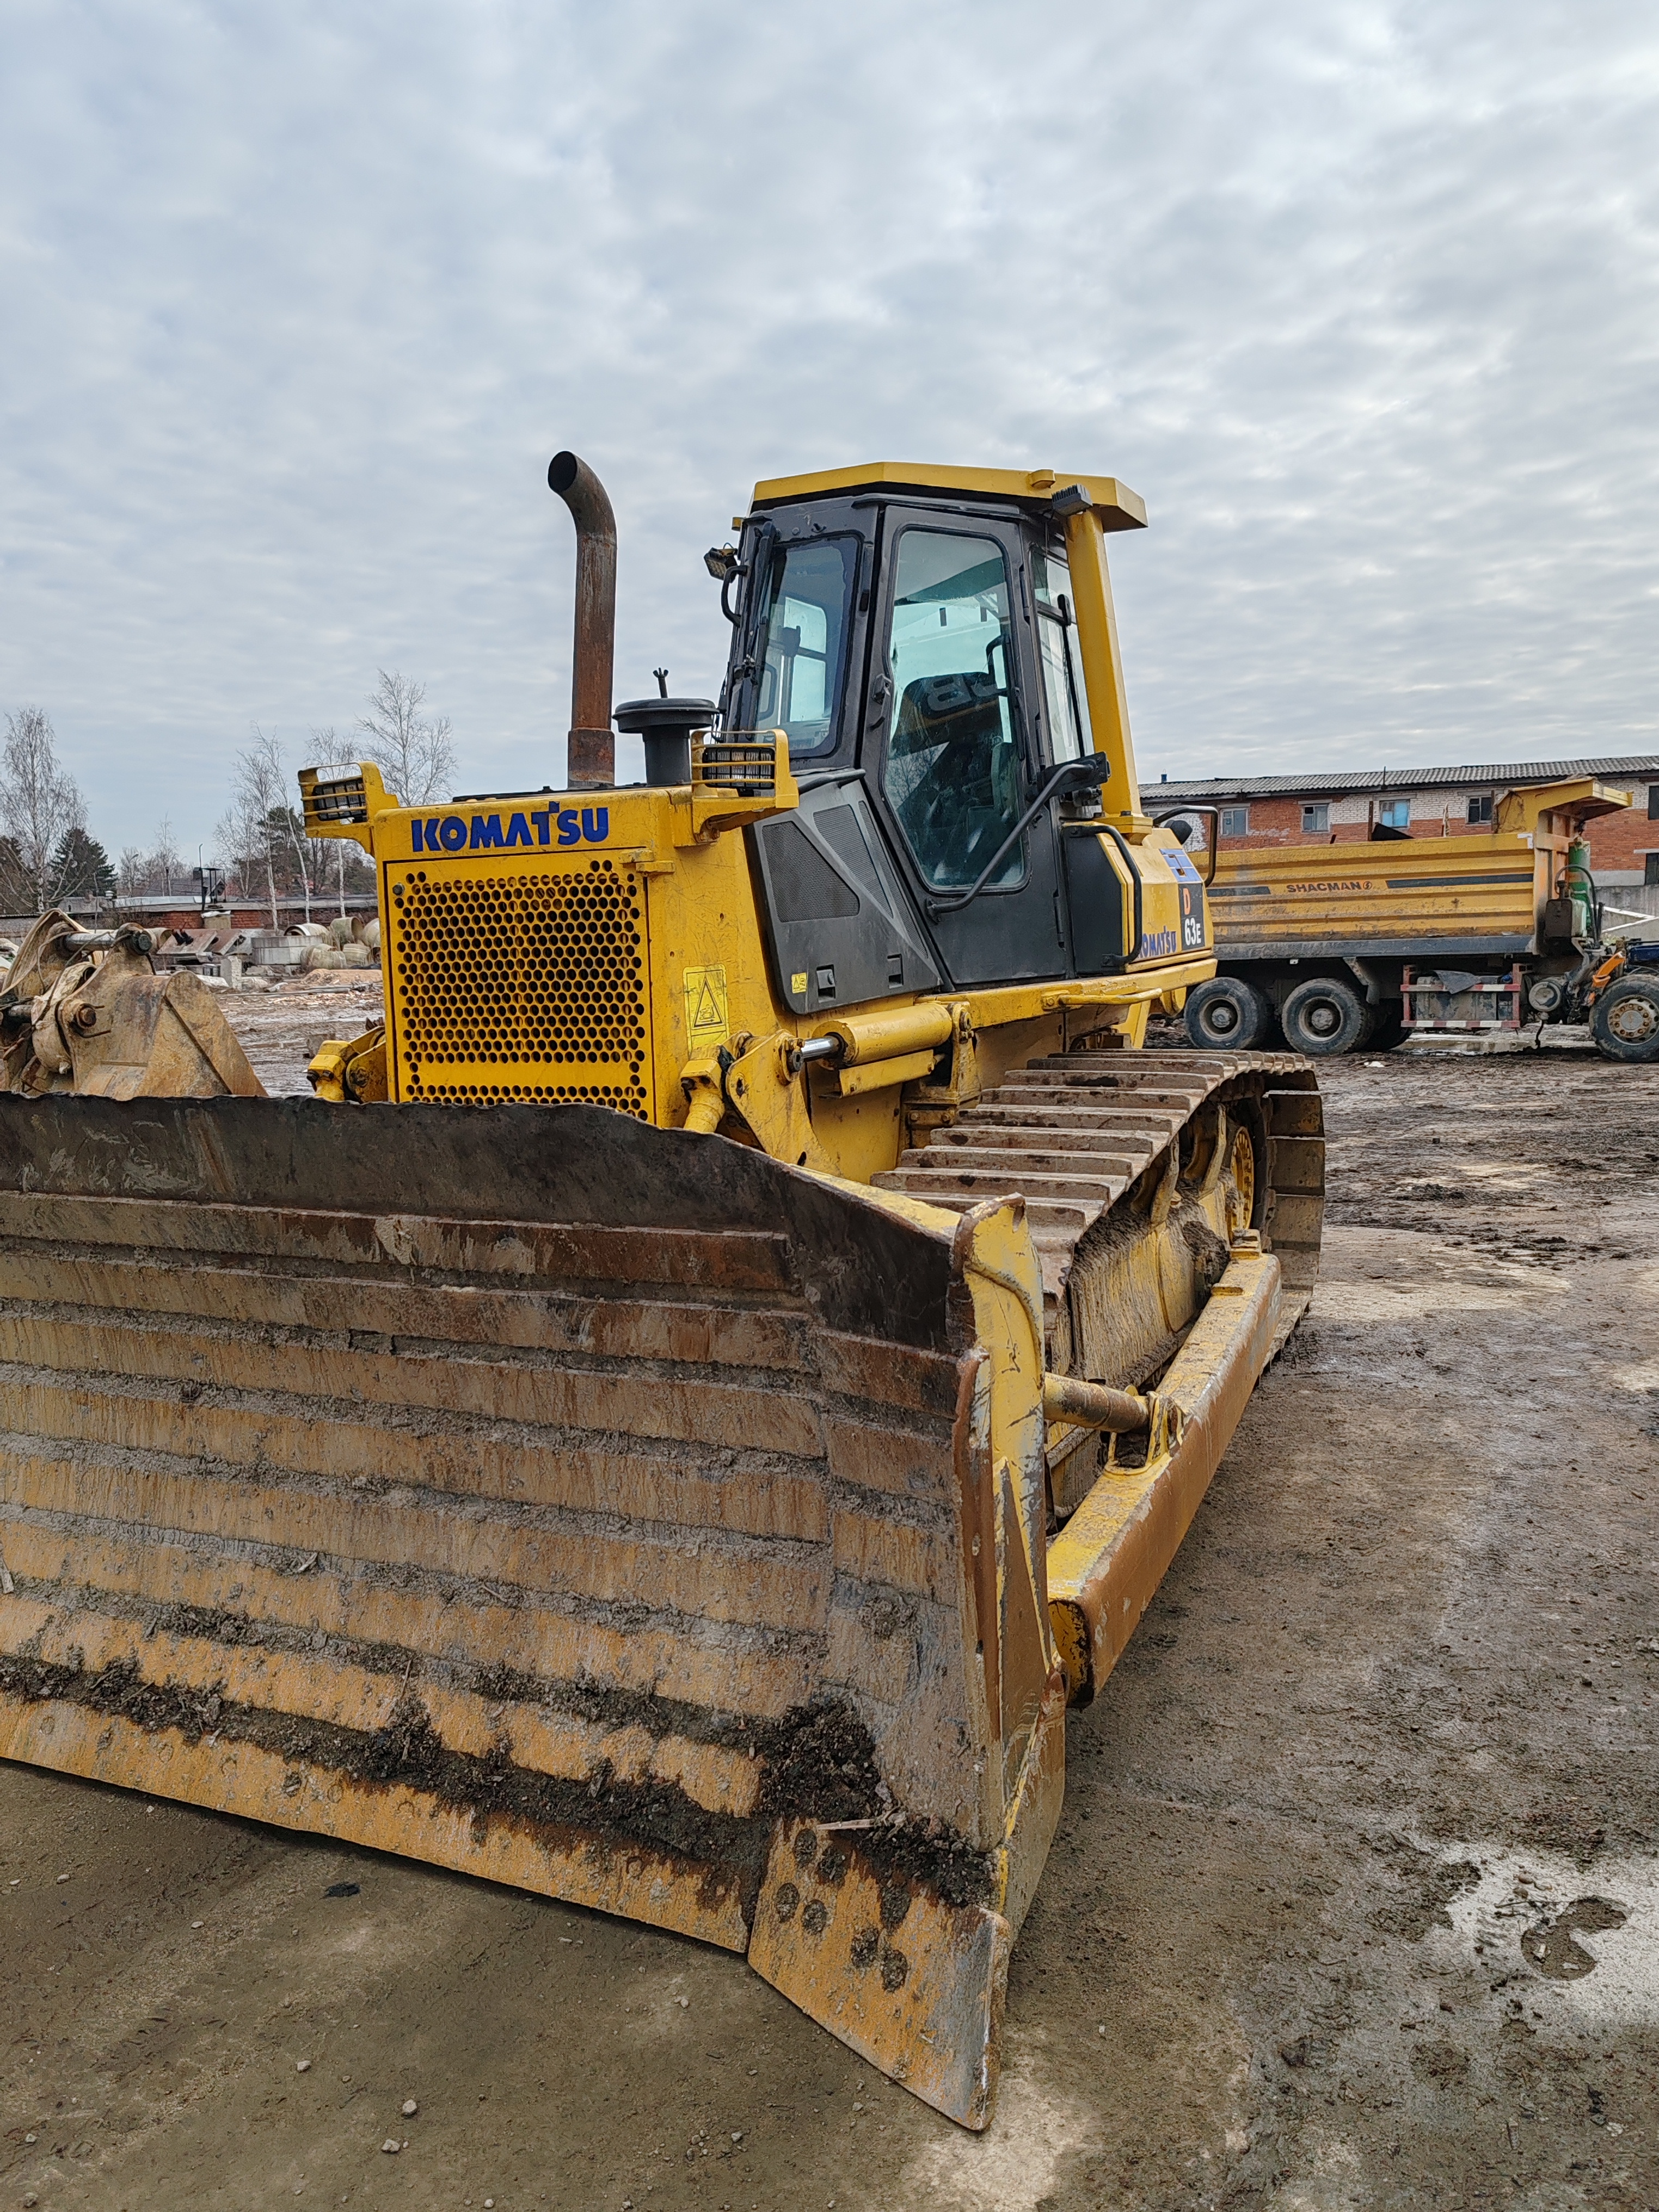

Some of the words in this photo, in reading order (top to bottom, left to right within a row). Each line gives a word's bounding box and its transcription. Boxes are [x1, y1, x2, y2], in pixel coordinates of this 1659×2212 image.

[411, 801, 609, 852] KOMATSU
[1286, 882, 1361, 893] SHACMAN
[1183, 888, 1191, 915] D
[1184, 918, 1201, 946] 63E
